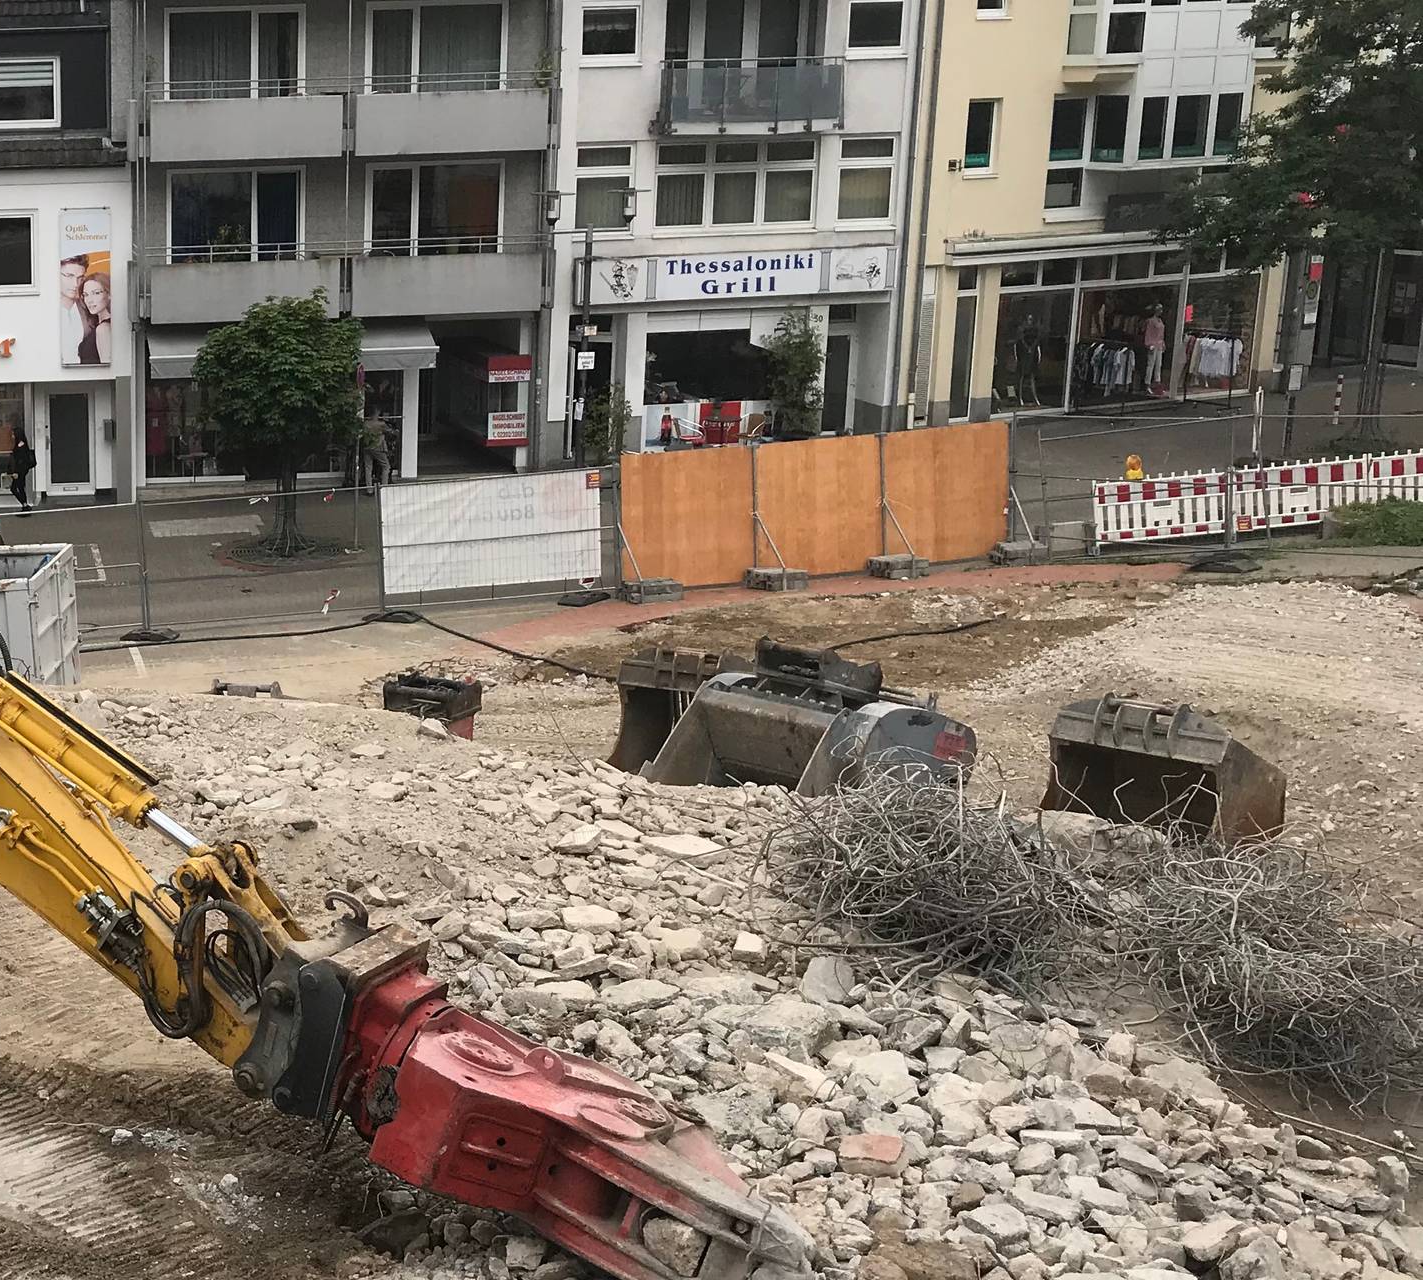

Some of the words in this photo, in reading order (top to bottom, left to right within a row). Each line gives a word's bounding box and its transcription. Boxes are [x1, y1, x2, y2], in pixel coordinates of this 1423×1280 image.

[65, 224, 88, 233] Optik
[666, 253, 814, 275] Thessaloniki
[701, 276, 776, 295] Grill
